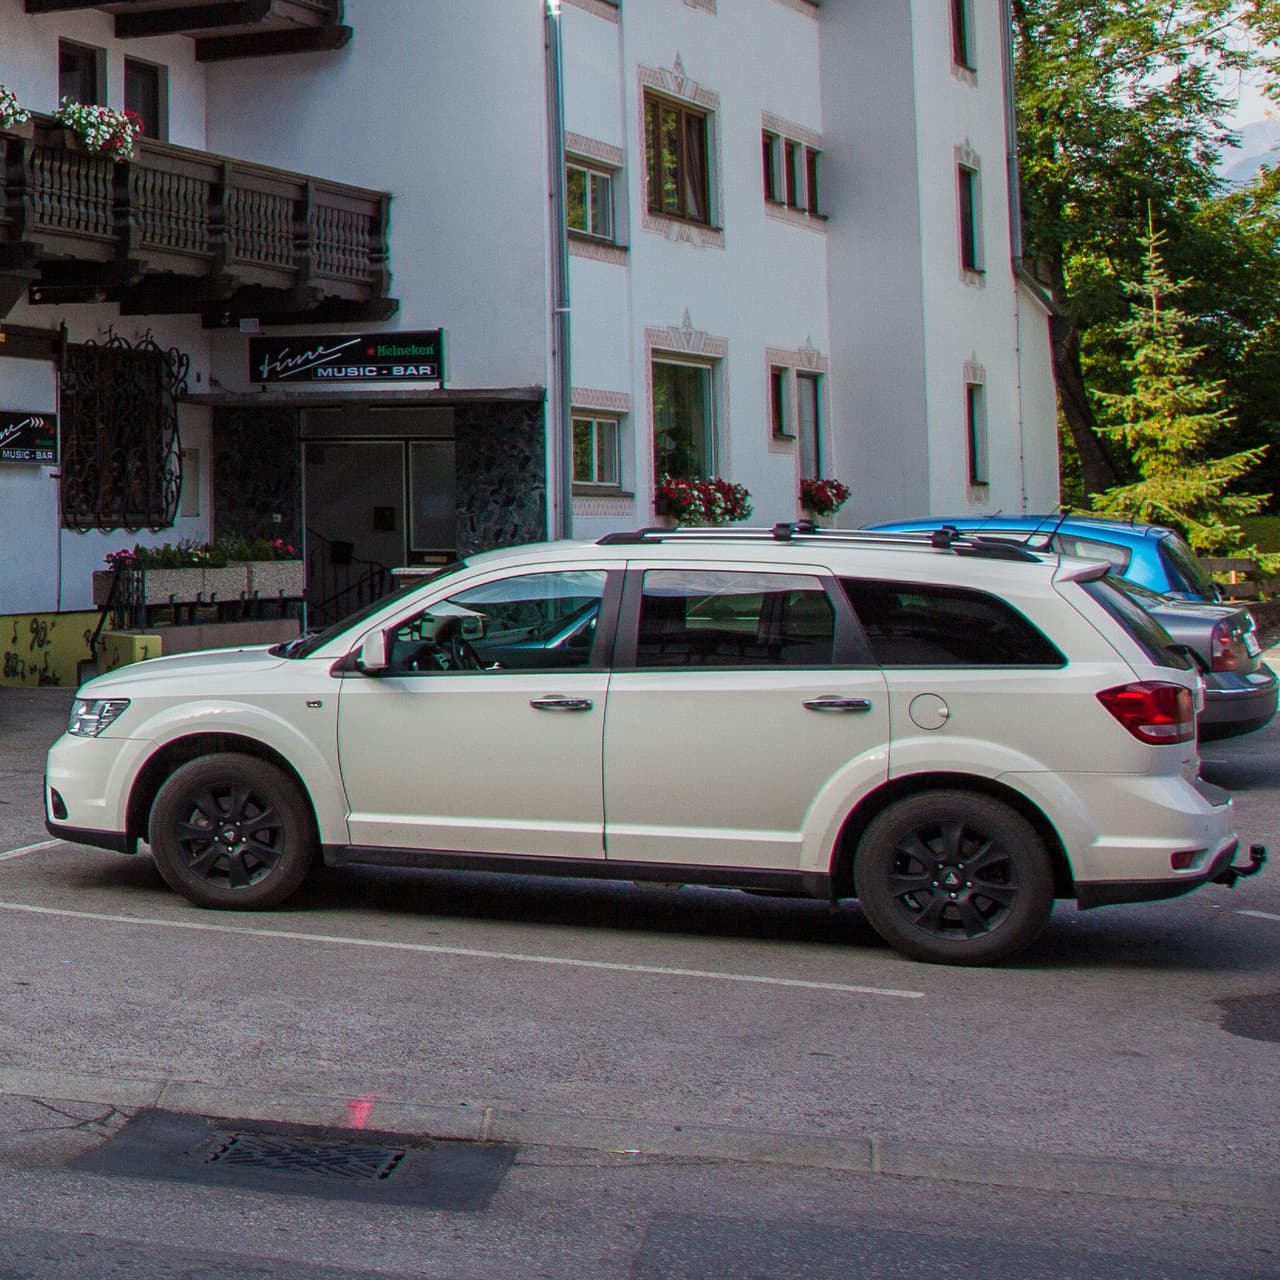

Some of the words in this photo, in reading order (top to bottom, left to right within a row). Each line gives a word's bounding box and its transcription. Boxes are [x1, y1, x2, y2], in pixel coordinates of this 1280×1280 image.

[376, 344, 435, 357] Heineken
[316, 366, 378, 378] MUSIC
[392, 365, 432, 377] BAR
[2, 450, 30, 459] MUSIC
[35, 451, 53, 460] BAR
